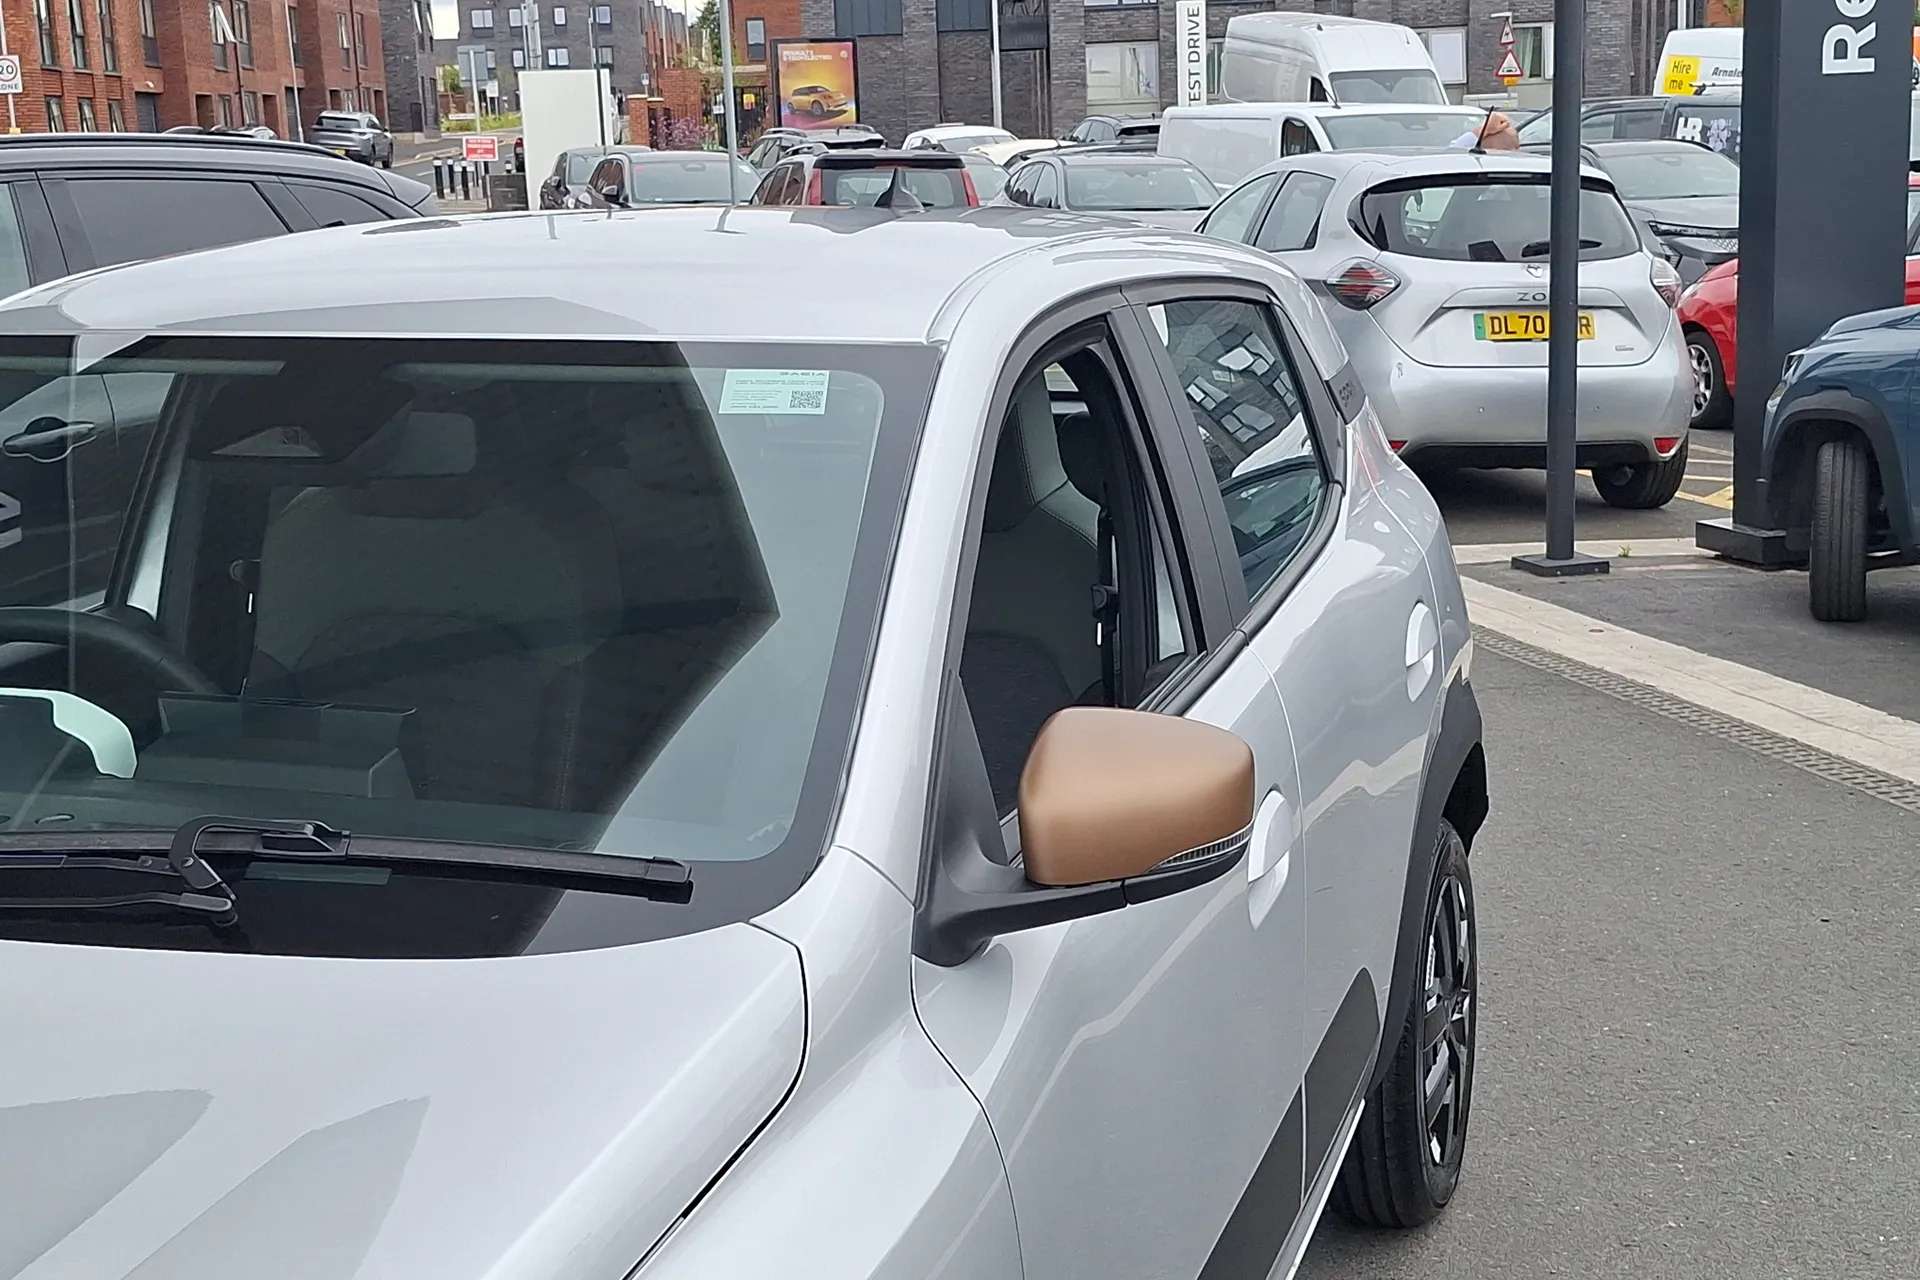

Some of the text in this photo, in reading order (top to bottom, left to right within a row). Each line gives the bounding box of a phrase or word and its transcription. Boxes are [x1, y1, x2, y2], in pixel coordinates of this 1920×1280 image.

[1187, 7, 1201, 63] DRIVE
[0, 65, 14, 75] 20
[1672, 60, 1692, 74] Hire
[1668, 80, 1683, 90] me
[1517, 292, 1547, 301] ZO
[1489, 315, 1546, 335] DL70
